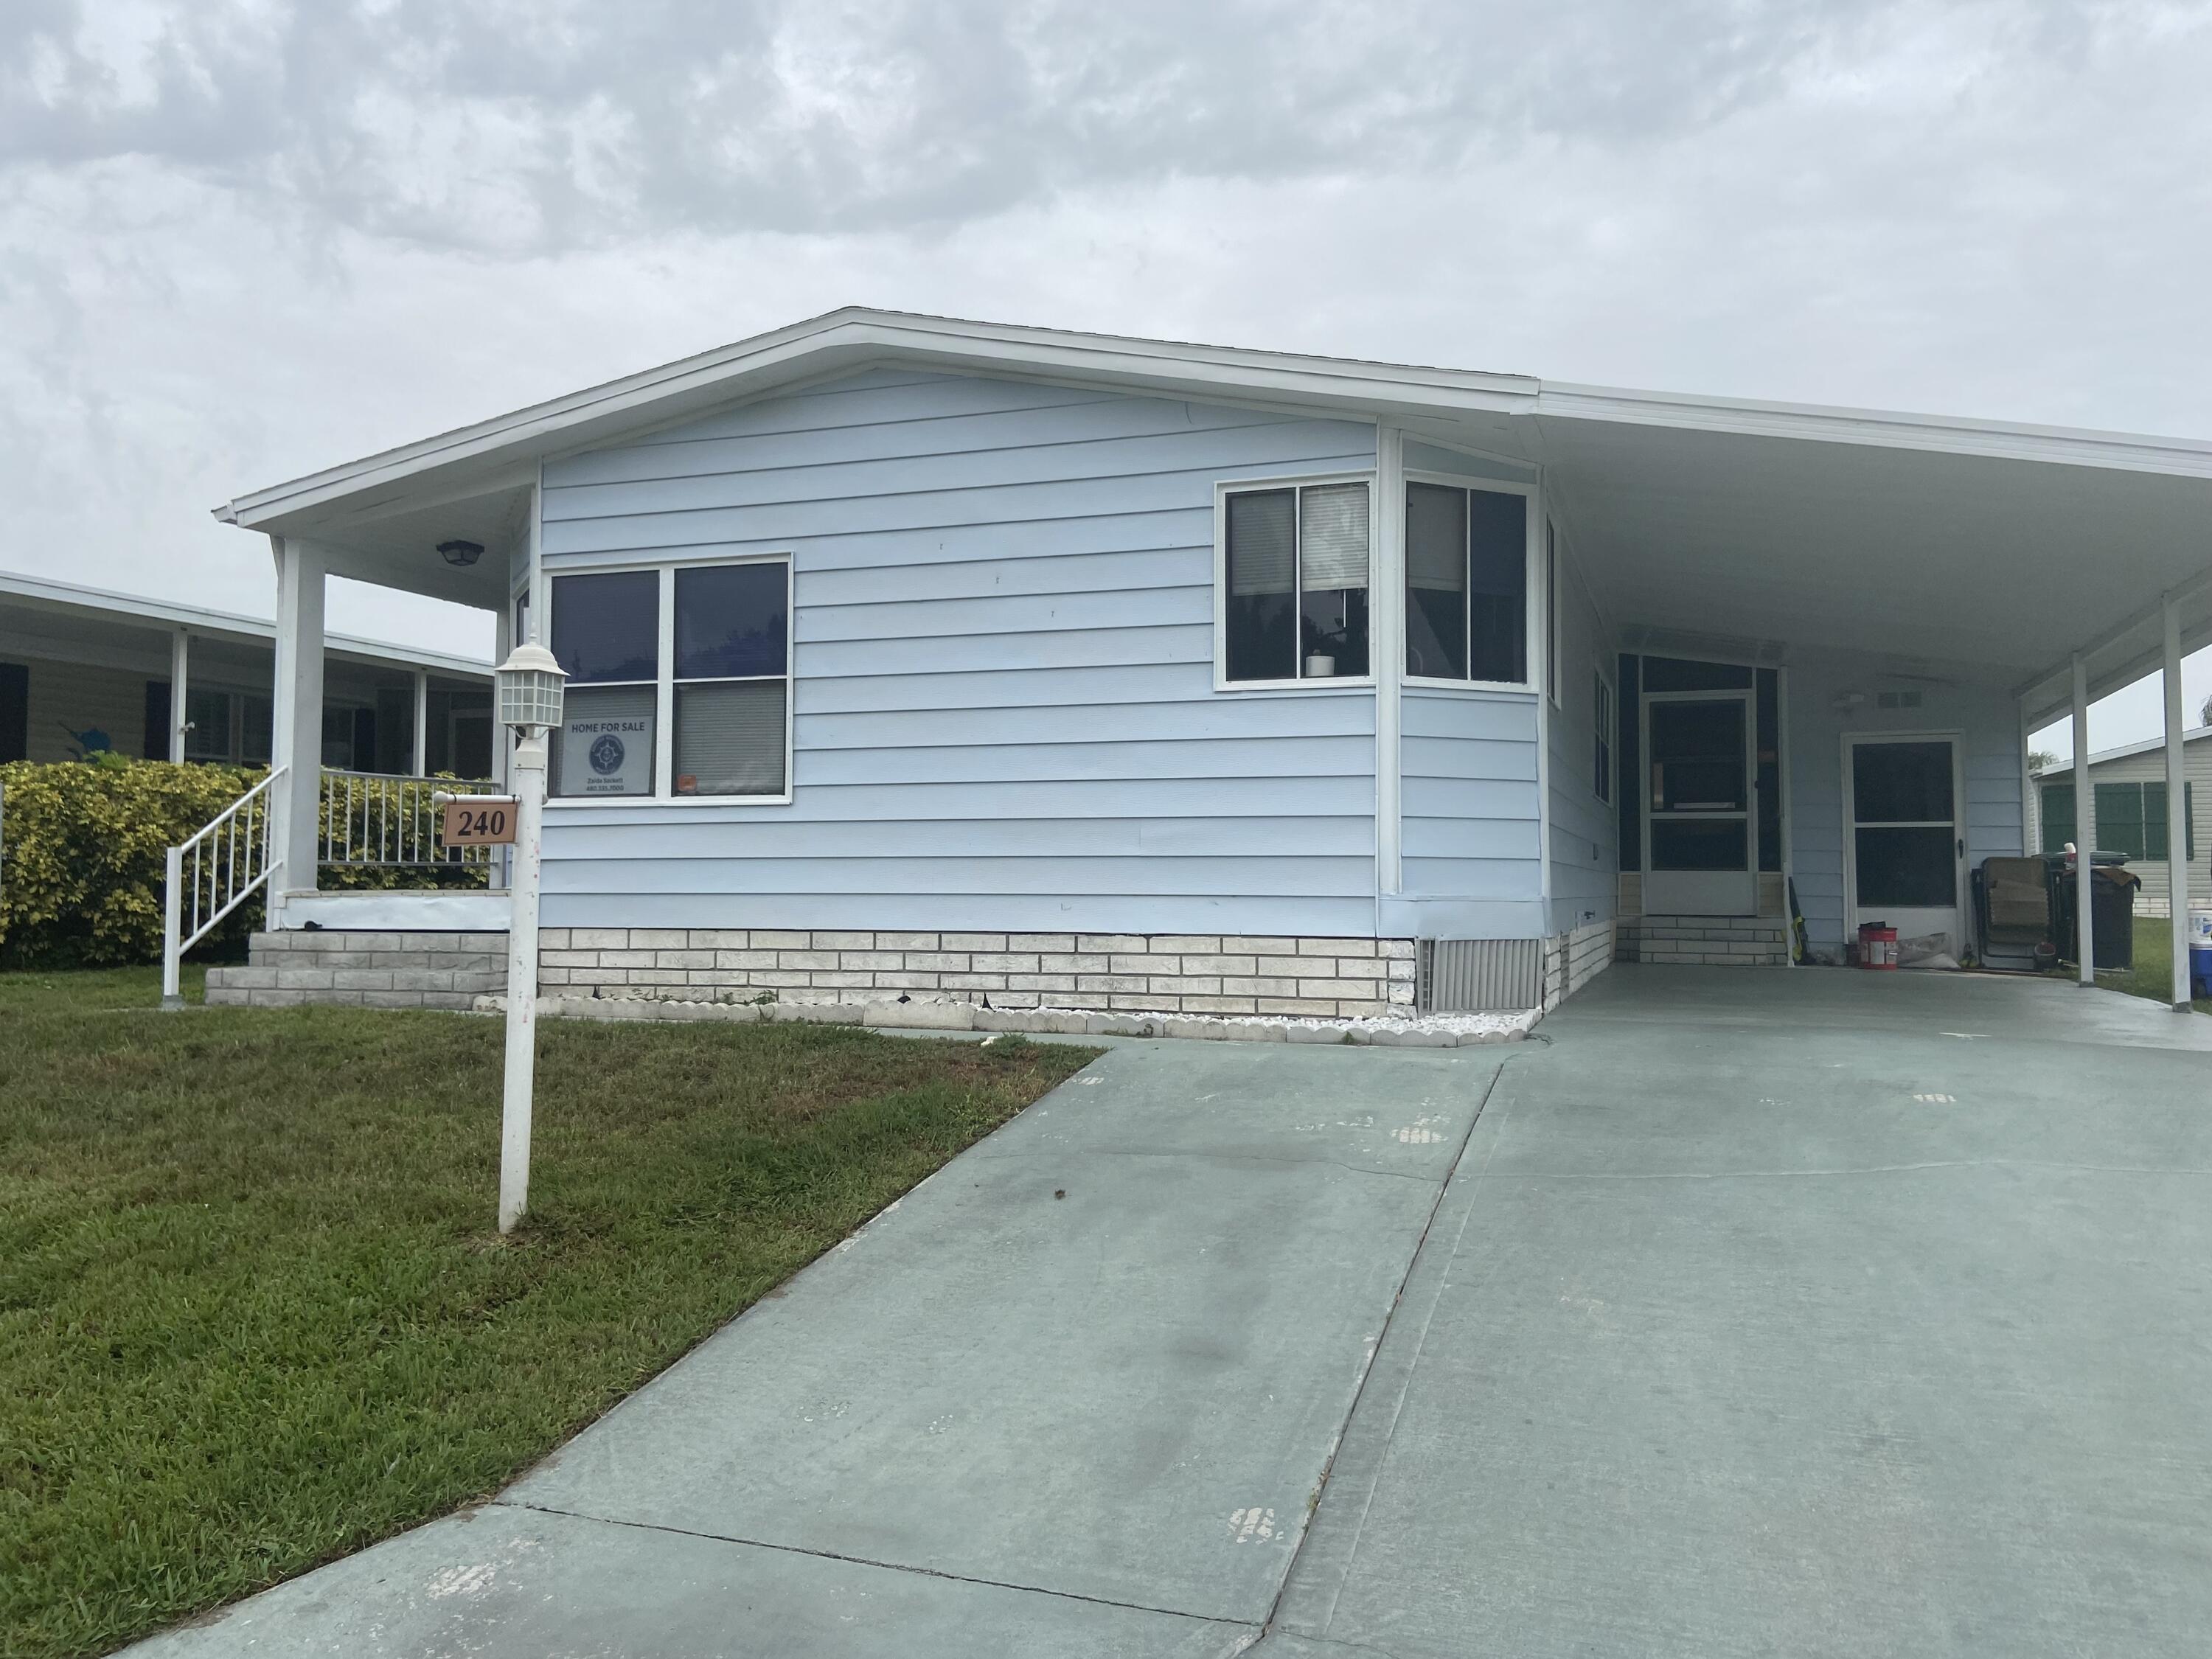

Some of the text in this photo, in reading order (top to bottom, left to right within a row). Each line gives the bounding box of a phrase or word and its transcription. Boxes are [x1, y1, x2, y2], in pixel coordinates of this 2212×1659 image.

[571, 722, 645, 733] HOME FOR SALE
[458, 810, 505, 836] 240
